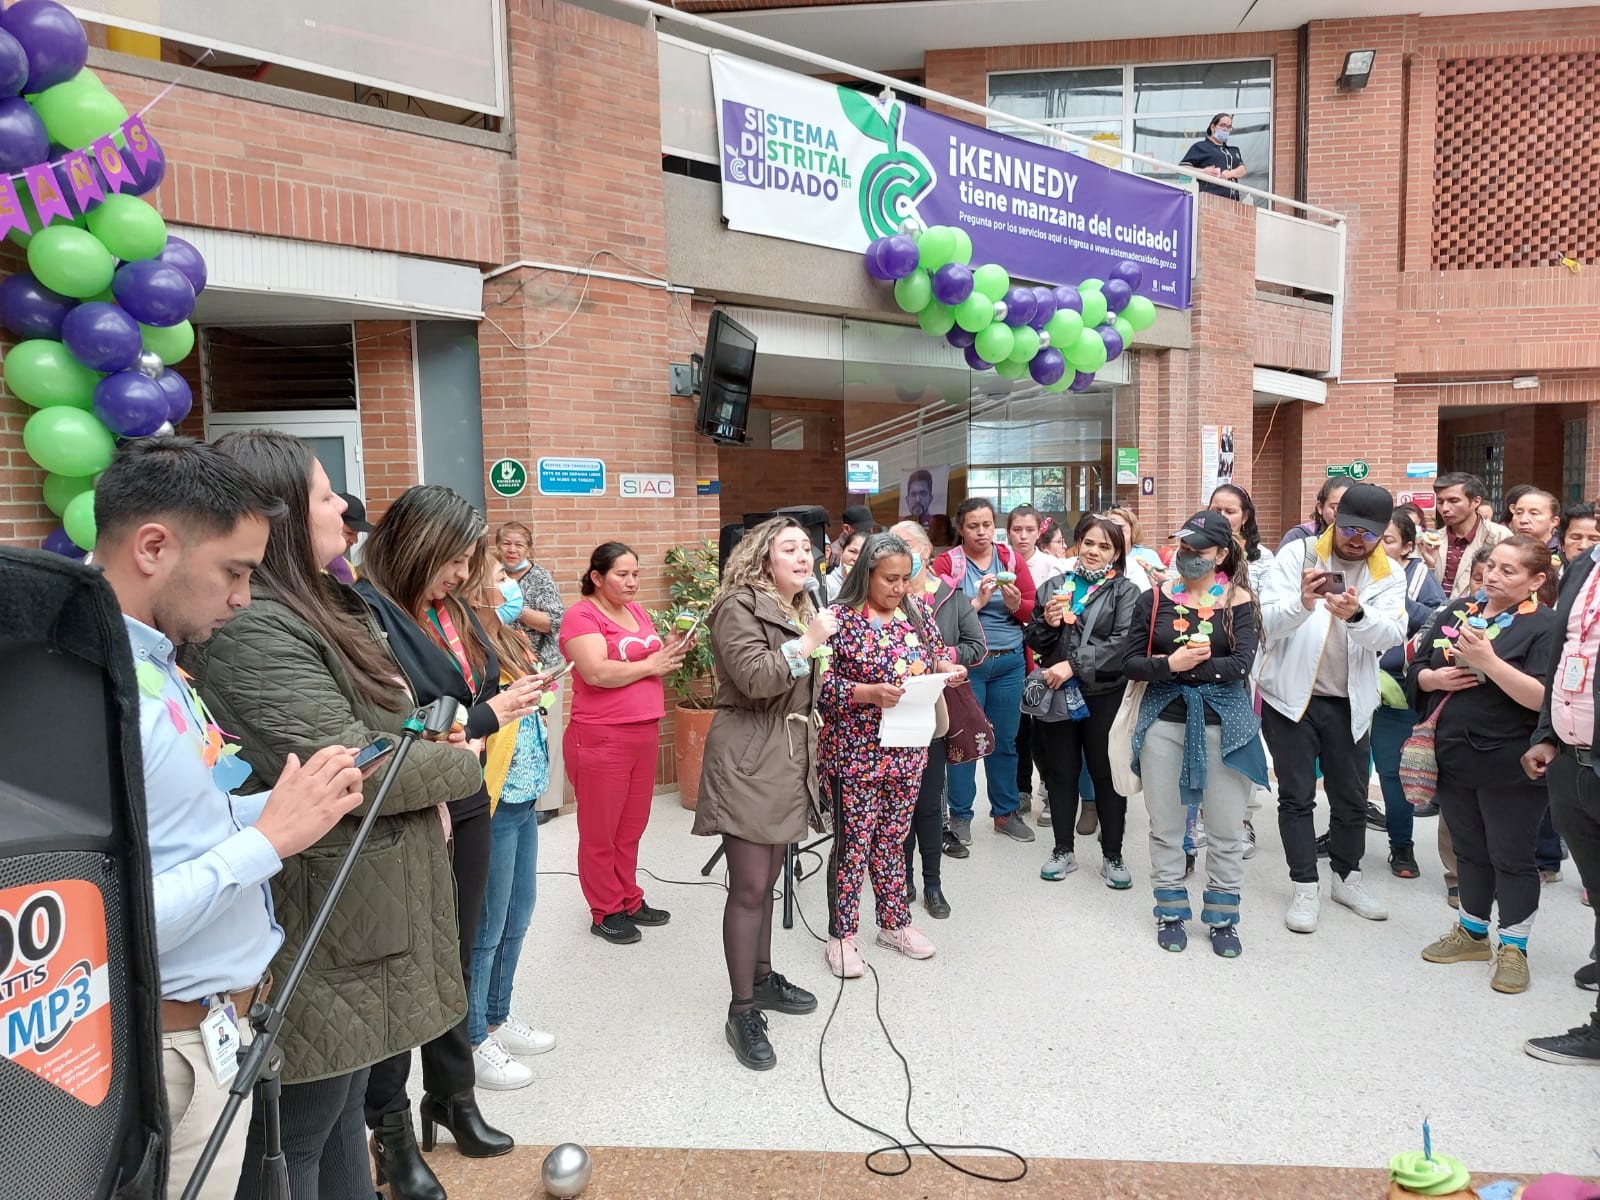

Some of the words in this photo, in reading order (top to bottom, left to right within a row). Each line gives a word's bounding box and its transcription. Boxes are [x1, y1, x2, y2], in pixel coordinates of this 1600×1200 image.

[744, 107, 839, 152] SISTEMA
[741, 131, 852, 179] DISTRITAL
[949, 135, 1078, 204] ¡KENNEDY
[729, 157, 839, 202] CUIDADO
[959, 180, 1008, 212] tiene
[1011, 197, 1085, 232] manzana
[1088, 213, 1112, 239] del
[1114, 223, 1178, 258] cuidado!
[959, 210, 993, 228] Pregunta
[993, 219, 1006, 231] por
[1006, 221, 1018, 234] los
[1018, 226, 1048, 240] servicios
[1048, 233, 1063, 246] aquí
[1063, 236, 1068, 244] o
[1068, 236, 1089, 250] ingresa
[1094, 244, 1177, 270] www.sistemadecuidado.gov.co
[623, 480, 672, 494] SIAC
[0, 964, 47, 1001] TTS
[8, 977, 92, 1056] MP3
